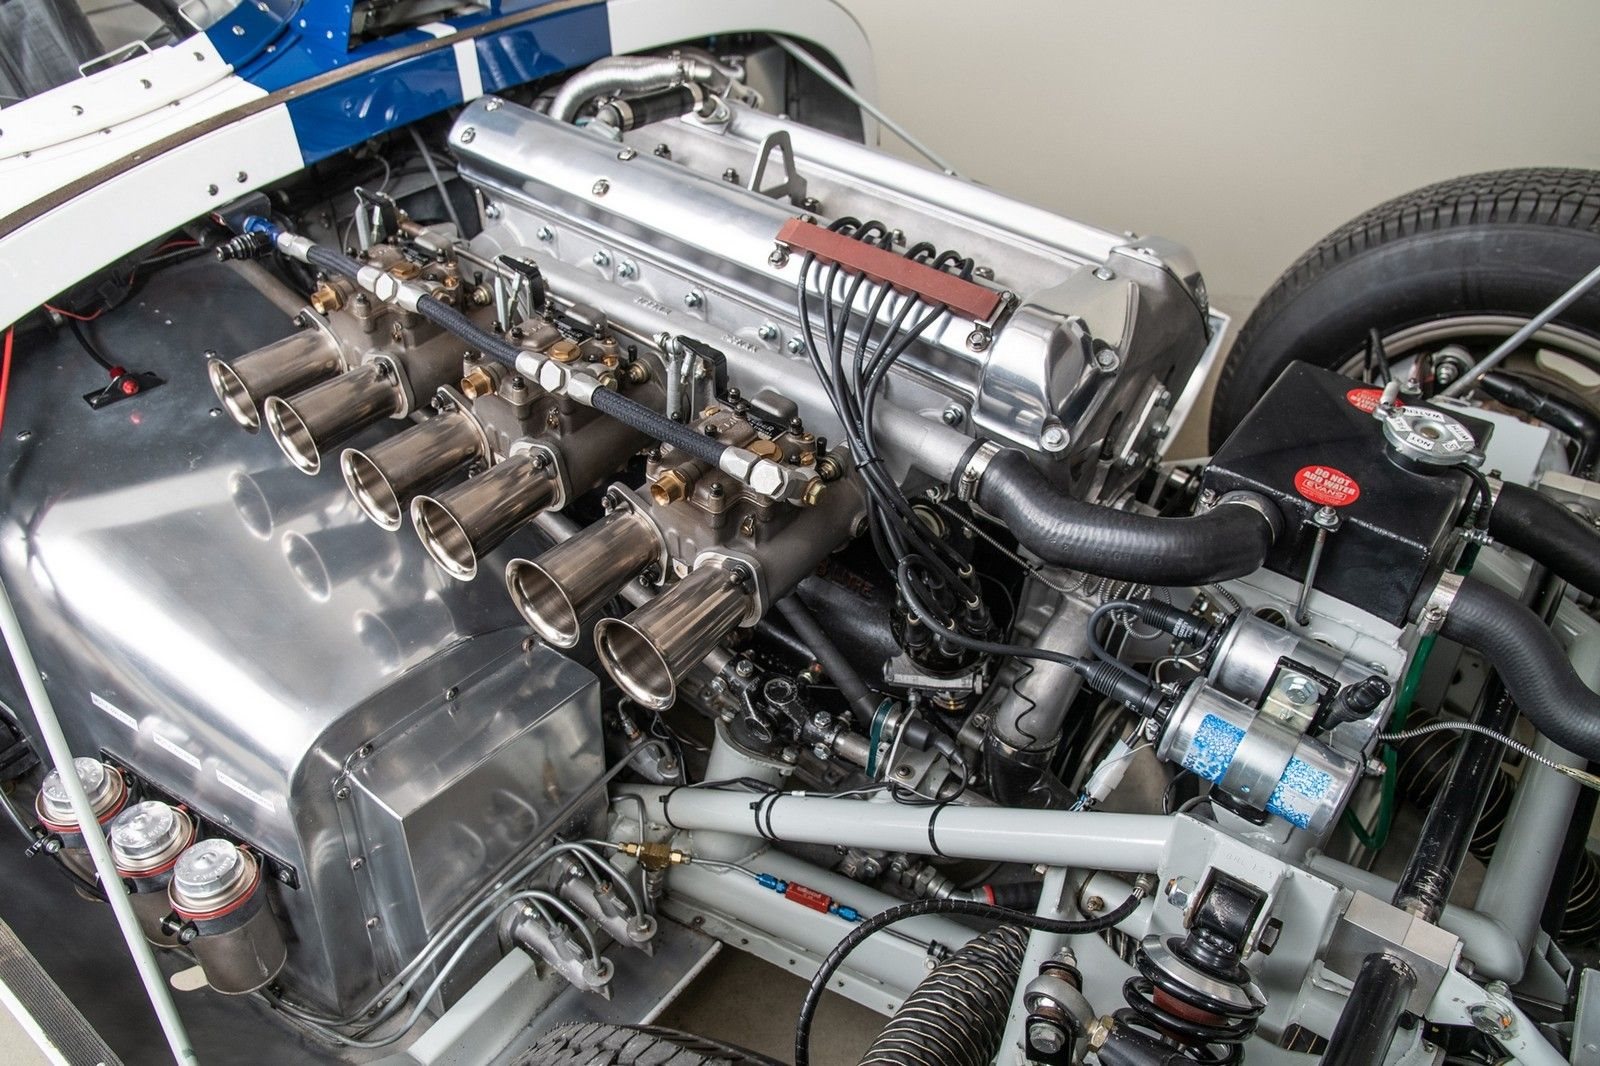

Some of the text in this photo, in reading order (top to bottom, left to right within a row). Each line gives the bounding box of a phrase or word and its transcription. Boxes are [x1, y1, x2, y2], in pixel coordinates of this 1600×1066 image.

[1411, 436, 1431, 448] NOT
[1303, 471, 1324, 483] ADD
[1323, 479, 1356, 496] WATER
[1315, 467, 1353, 487] DO NOT
[1306, 480, 1345, 498] EVANS
